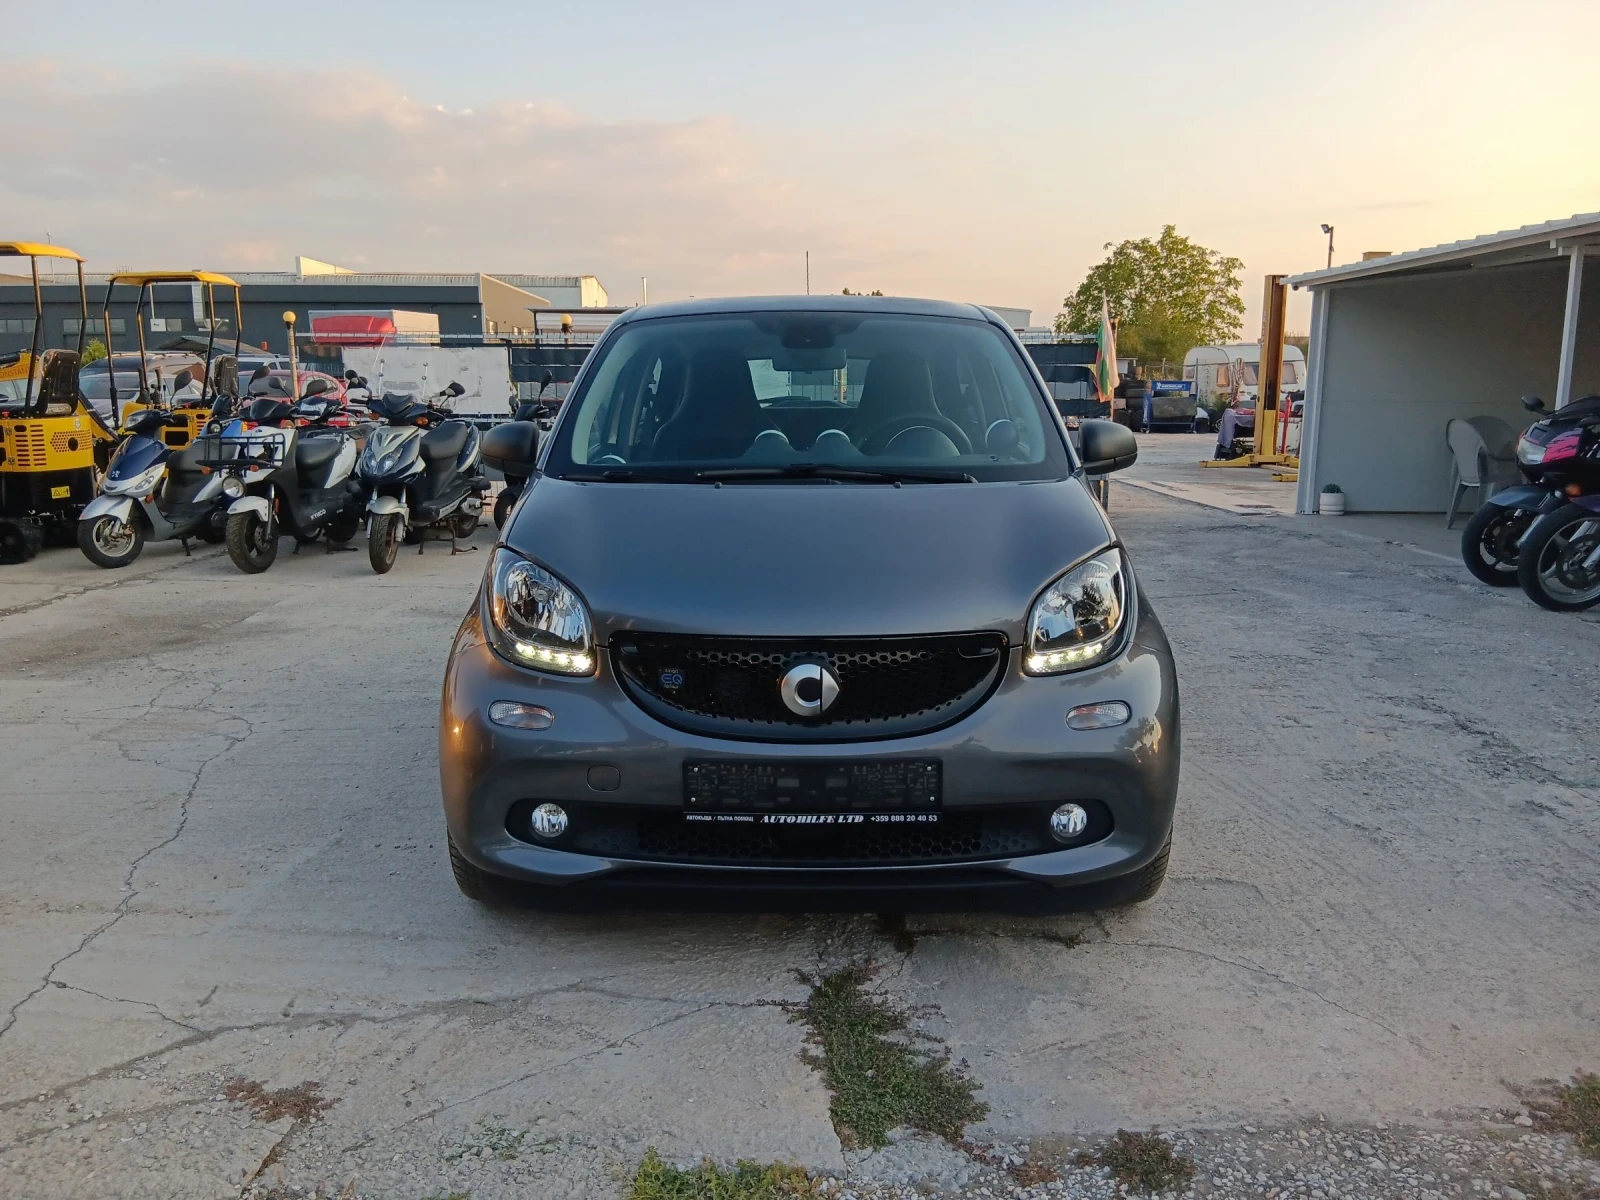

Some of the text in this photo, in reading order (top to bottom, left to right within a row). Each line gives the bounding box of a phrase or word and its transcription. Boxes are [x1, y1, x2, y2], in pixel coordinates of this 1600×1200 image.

[662, 674, 682, 684] EQ
[760, 815, 864, 823] AUTOHILFE LTD
